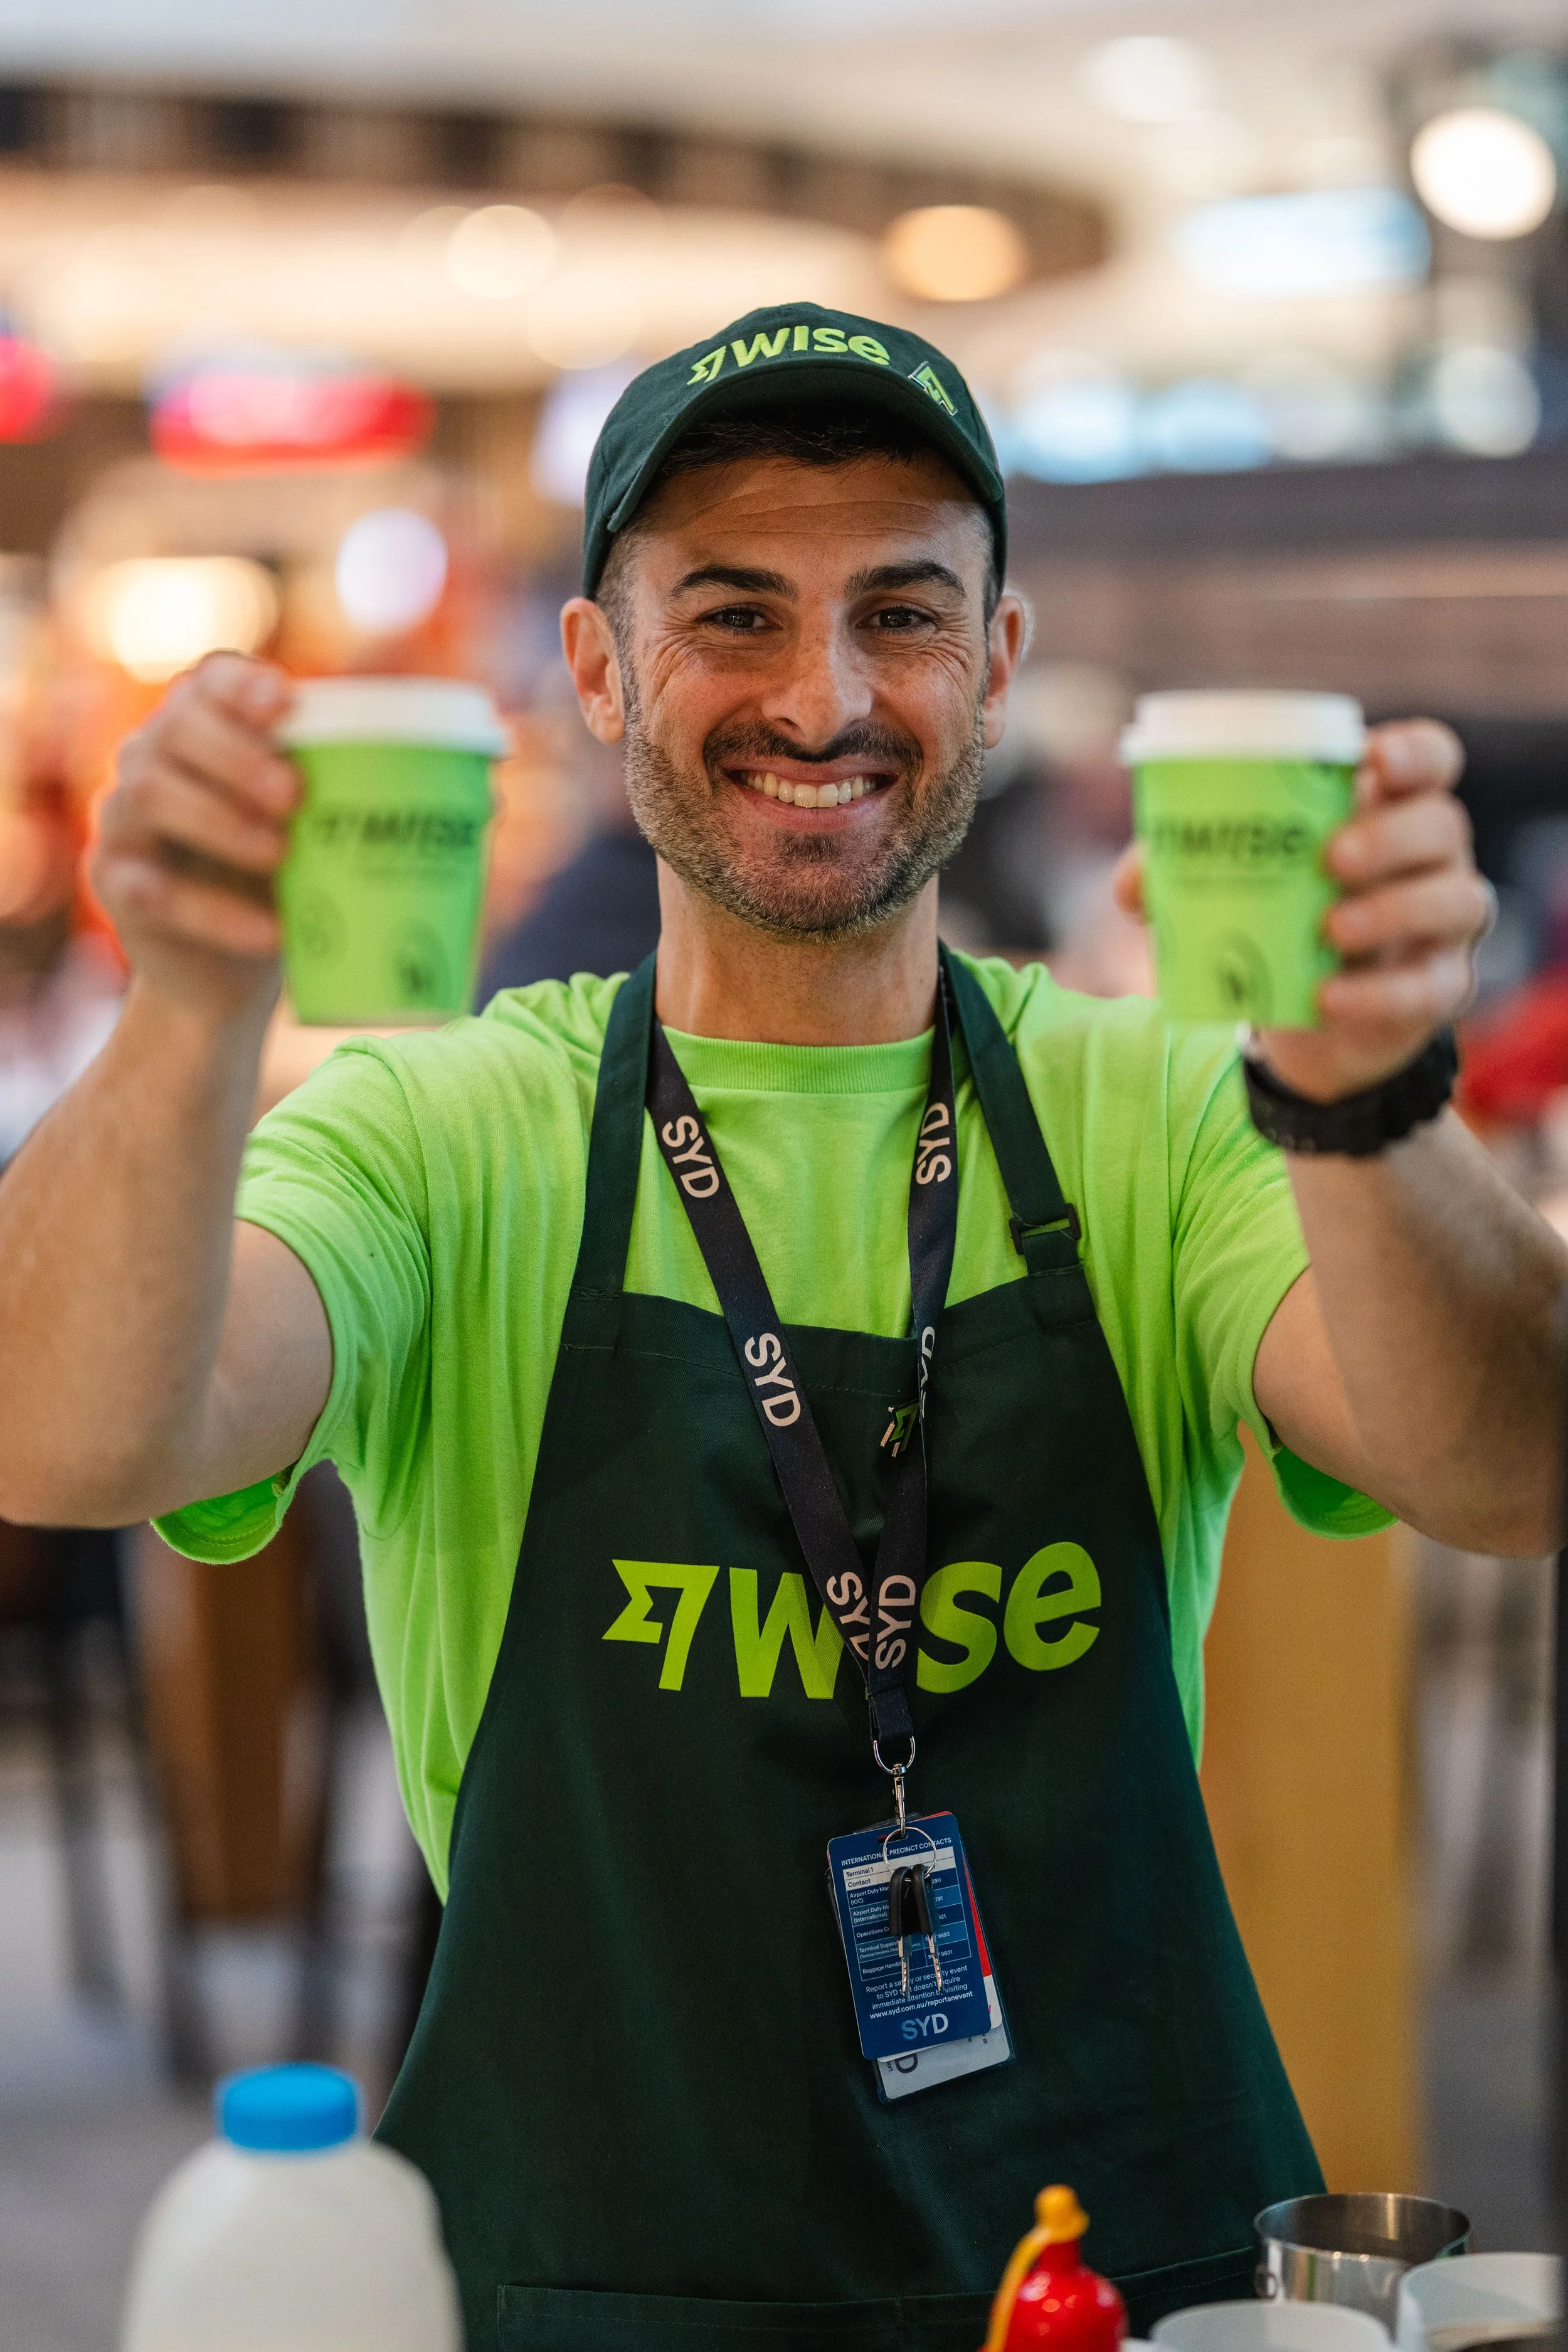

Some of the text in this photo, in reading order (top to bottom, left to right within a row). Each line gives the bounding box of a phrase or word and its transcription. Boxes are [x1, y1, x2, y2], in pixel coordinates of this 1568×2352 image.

[916, 1102, 951, 1185] SYD
[662, 1115, 719, 1198] SYD
[744, 1332, 801, 1427] SYD
[729, 1541, 1102, 1700] wse
[875, 1575, 916, 1670] SYD
[841, 1849, 889, 1867] INTERNATION
[889, 1845, 918, 1856] PRECINCT
[846, 1867, 870, 1877] Terminal
[848, 1878, 871, 1887] Contact
[850, 1890, 867, 1899] Airport
[854, 1911, 887, 1924] (International)
[856, 1928, 883, 1938] Operations
[859, 1944, 879, 1953] Terminal
[880, 1940, 899, 1949] Supervi
[862, 1966, 884, 1974] Baggage
[866, 1983, 888, 1993] Report
[894, 1978, 914, 1987] say
[923, 1970, 948, 1980] secty
[950, 1965, 968, 1974] event
[869, 1991, 973, 2019] www.syd.com.au/reportanevent
[872, 1998, 906, 2010] immediate
[907, 1991, 935, 2002] attention
[945, 1984, 968, 1993] visiting
[884, 1989, 898, 1998] SYD
[901, 2013, 949, 2040] SYD
